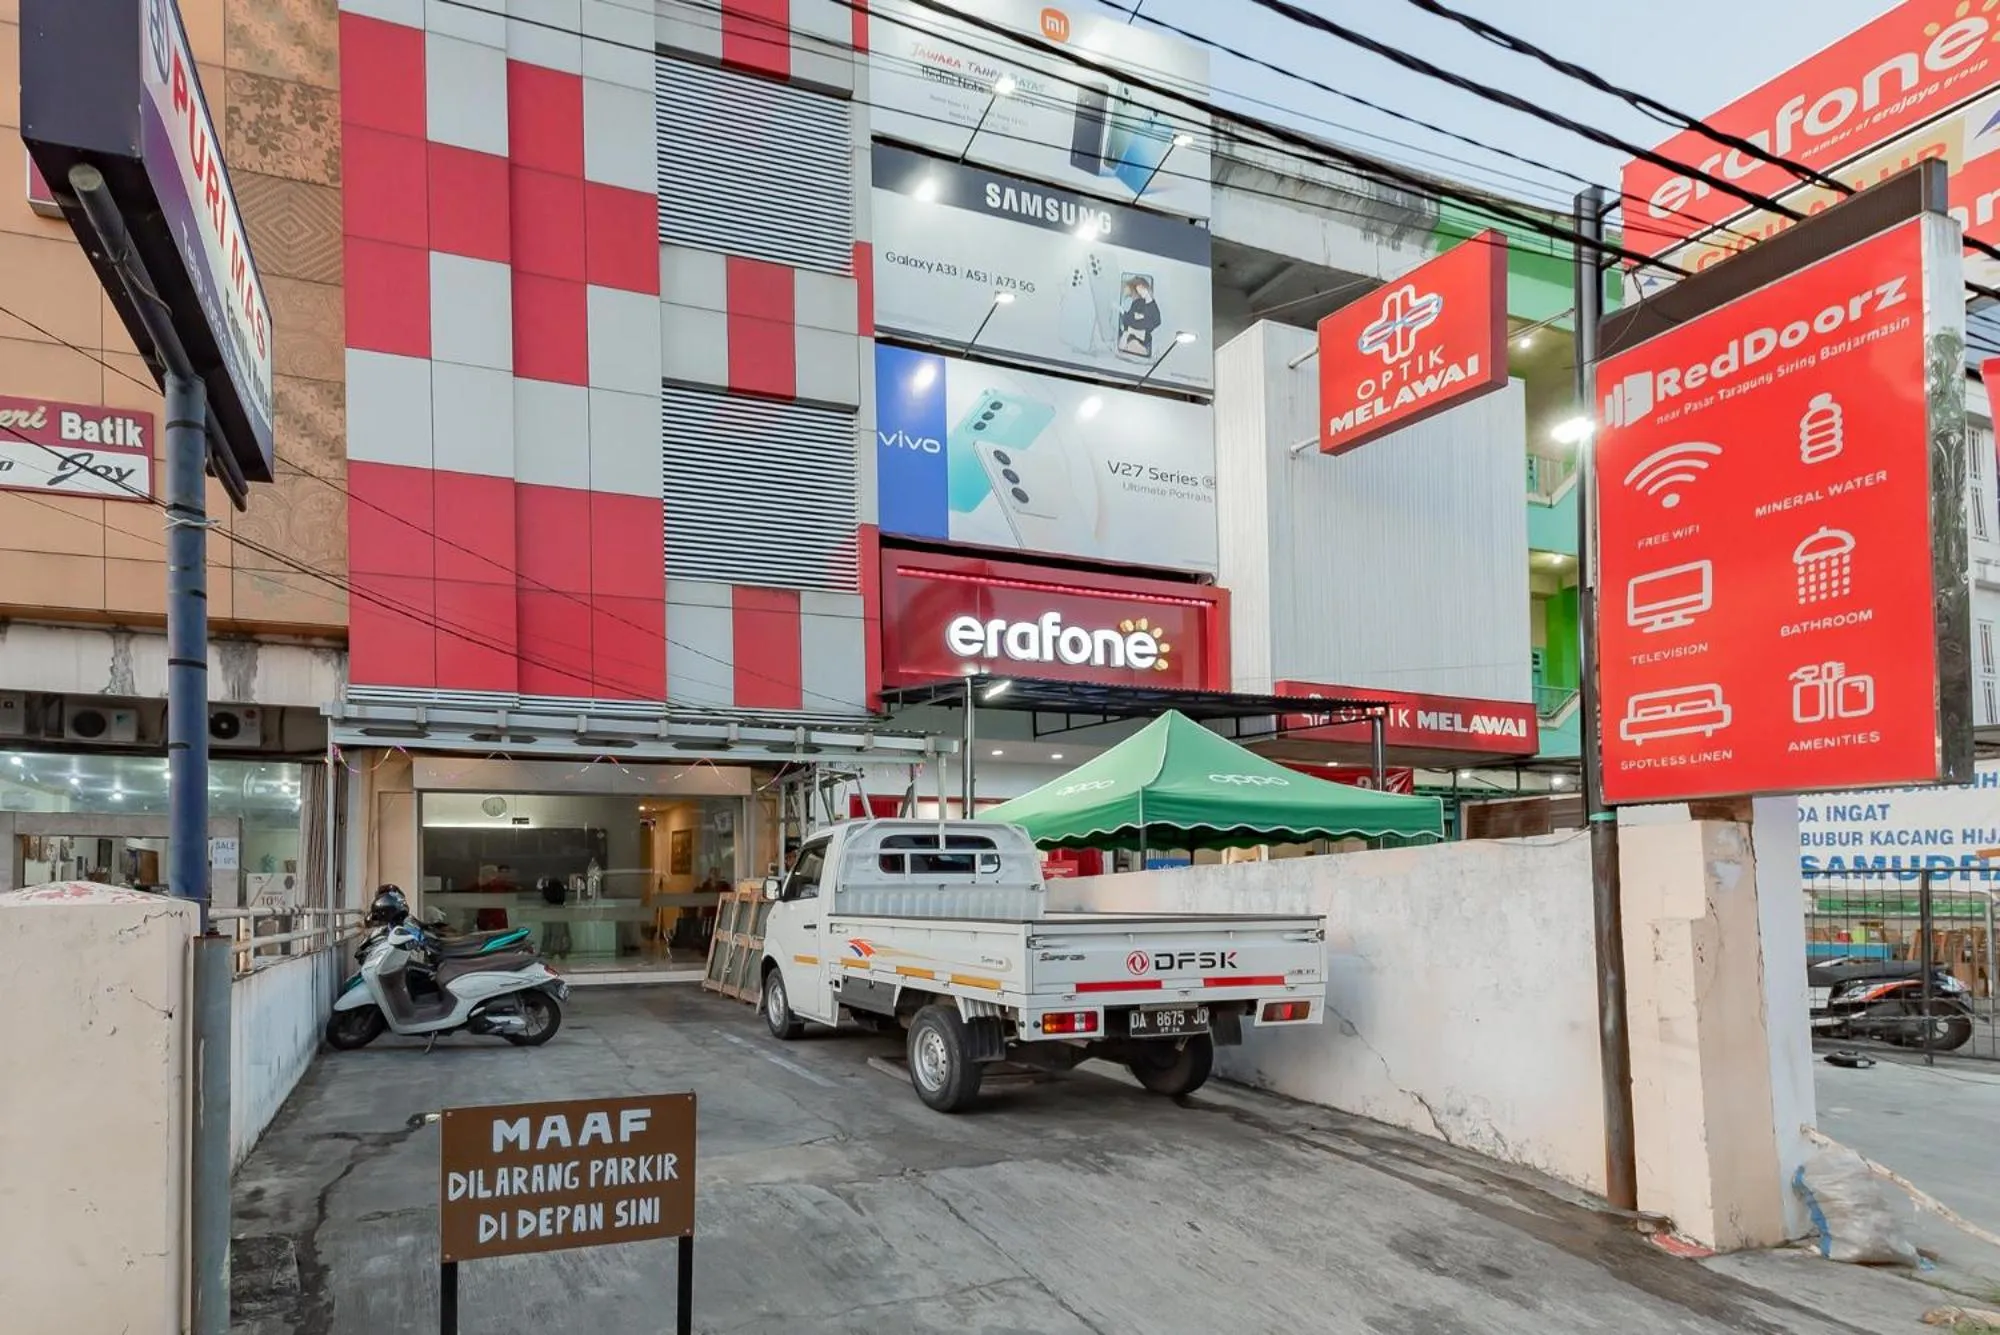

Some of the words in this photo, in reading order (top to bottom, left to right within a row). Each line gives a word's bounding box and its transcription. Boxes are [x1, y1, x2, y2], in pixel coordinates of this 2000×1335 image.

[1648, 16, 1989, 219] erafone
[1800, 128, 1852, 160] member
[1943, 58, 1989, 90] group
[172, 48, 227, 250] PURI
[231, 231, 266, 361] MAS
[985, 182, 1112, 234] SAMSUNG
[885, 251, 934, 273] Galaxy
[935, 261, 957, 277] A33
[966, 267, 988, 283] A53
[995, 273, 1017, 288] A73
[1019, 279, 1036, 294] 5G
[1656, 275, 1908, 401] RedDoorz
[1356, 344, 1445, 400] OPTIK
[1656, 407, 1681, 425] near
[1683, 396, 1715, 416] Pasar
[1776, 354, 1816, 378] Siring
[1819, 316, 1911, 361] Banjarmasin
[1329, 354, 1480, 437] MELAWAI
[61, 411, 144, 448] Batik
[879, 430, 941, 454] vivo
[1107, 460, 1144, 478] V27
[1148, 467, 1199, 487] Series
[1122, 481, 1167, 497] Ultimate
[1755, 490, 1824, 518] MINERAL
[1828, 470, 1888, 497] WATER
[1637, 531, 1670, 549] FREE
[1672, 525, 1700, 542] WIFI
[1779, 609, 1874, 637] BATHROOM
[947, 611, 1159, 669] erafone
[1630, 642, 1709, 666] TELEVISION
[1416, 709, 1527, 738] MELAWAI
[1788, 731, 1881, 753] AMENITIES
[1620, 753, 1688, 771] SPOTLESS
[1690, 749, 1733, 765] LINEN
[1208, 773, 1290, 788] oppo
[1826, 804, 1891, 822] INGAT
[1800, 831, 1863, 846] BUBUR
[1870, 829, 1954, 846] KACANG
[1962, 828, 2000, 845] HIJ
[1800, 854, 2000, 882] SAMUDR
[1154, 951, 1238, 970] DFSK
[1131, 1012, 1147, 1029] DA
[1156, 1010, 1185, 1027] 8675
[492, 1108, 652, 1153] MAAF
[448, 1160, 580, 1202] DILARANG
[589, 1153, 679, 1189] PARKIR
[478, 1212, 508, 1244] DI
[516, 1202, 604, 1240] DEPAN
[614, 1196, 661, 1229] SINI
